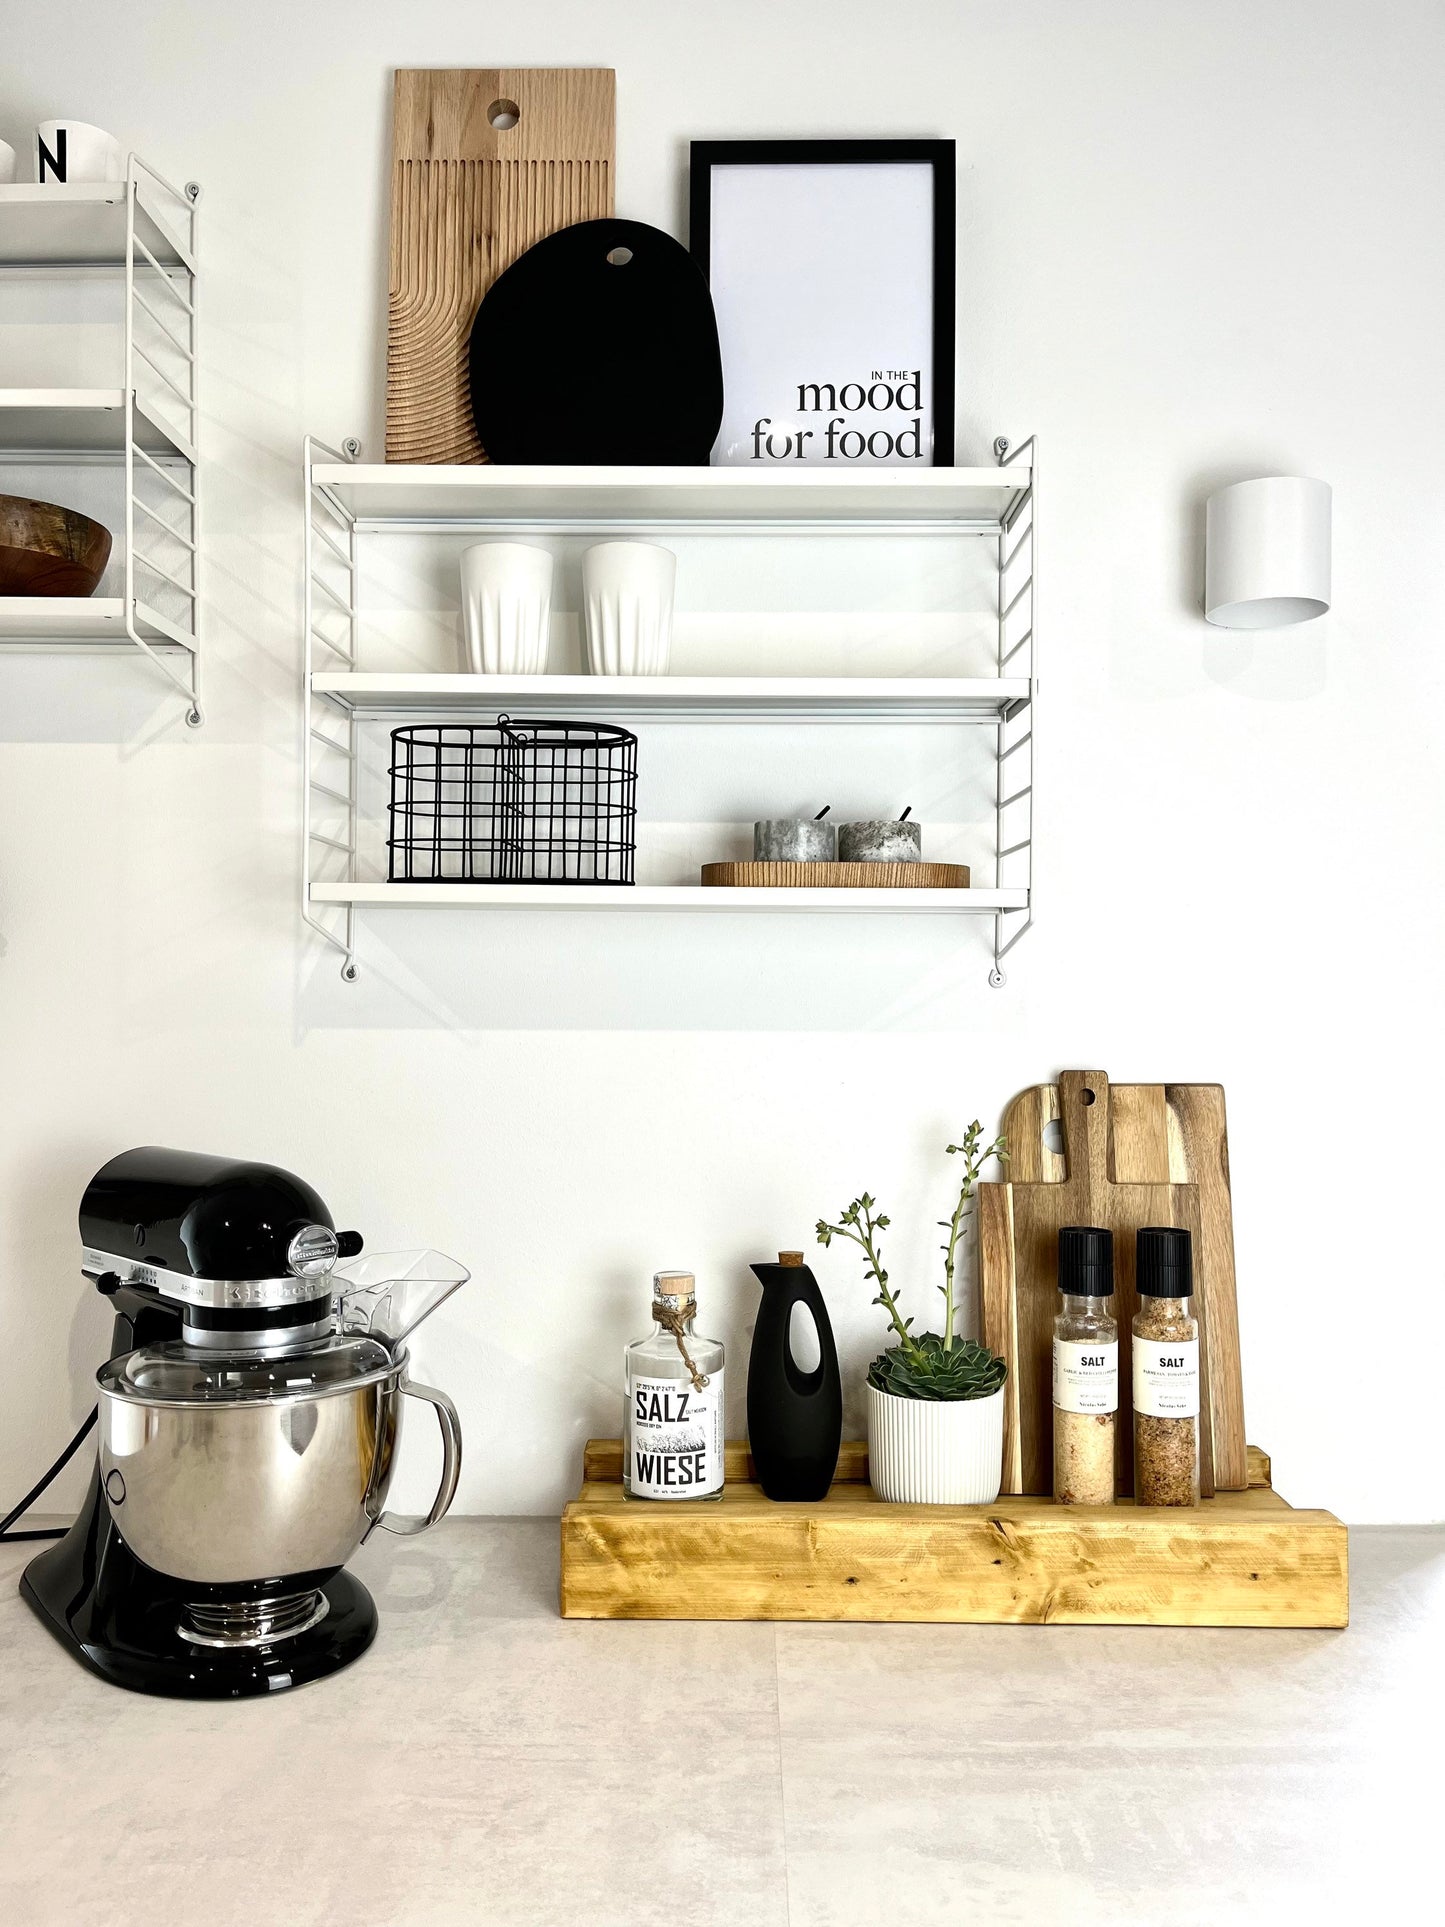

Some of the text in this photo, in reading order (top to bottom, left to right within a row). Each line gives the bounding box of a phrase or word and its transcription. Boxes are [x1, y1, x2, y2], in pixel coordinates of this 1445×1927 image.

[38, 129, 67, 183] N
[796, 370, 924, 412] mood
[871, 370, 909, 380] IN THE
[750, 417, 924, 459] for food
[1081, 1356, 1105, 1367] SALT
[1159, 1357, 1184, 1368] SALT
[636, 1390, 690, 1422] SALZ
[636, 1452, 706, 1485] WIESE
